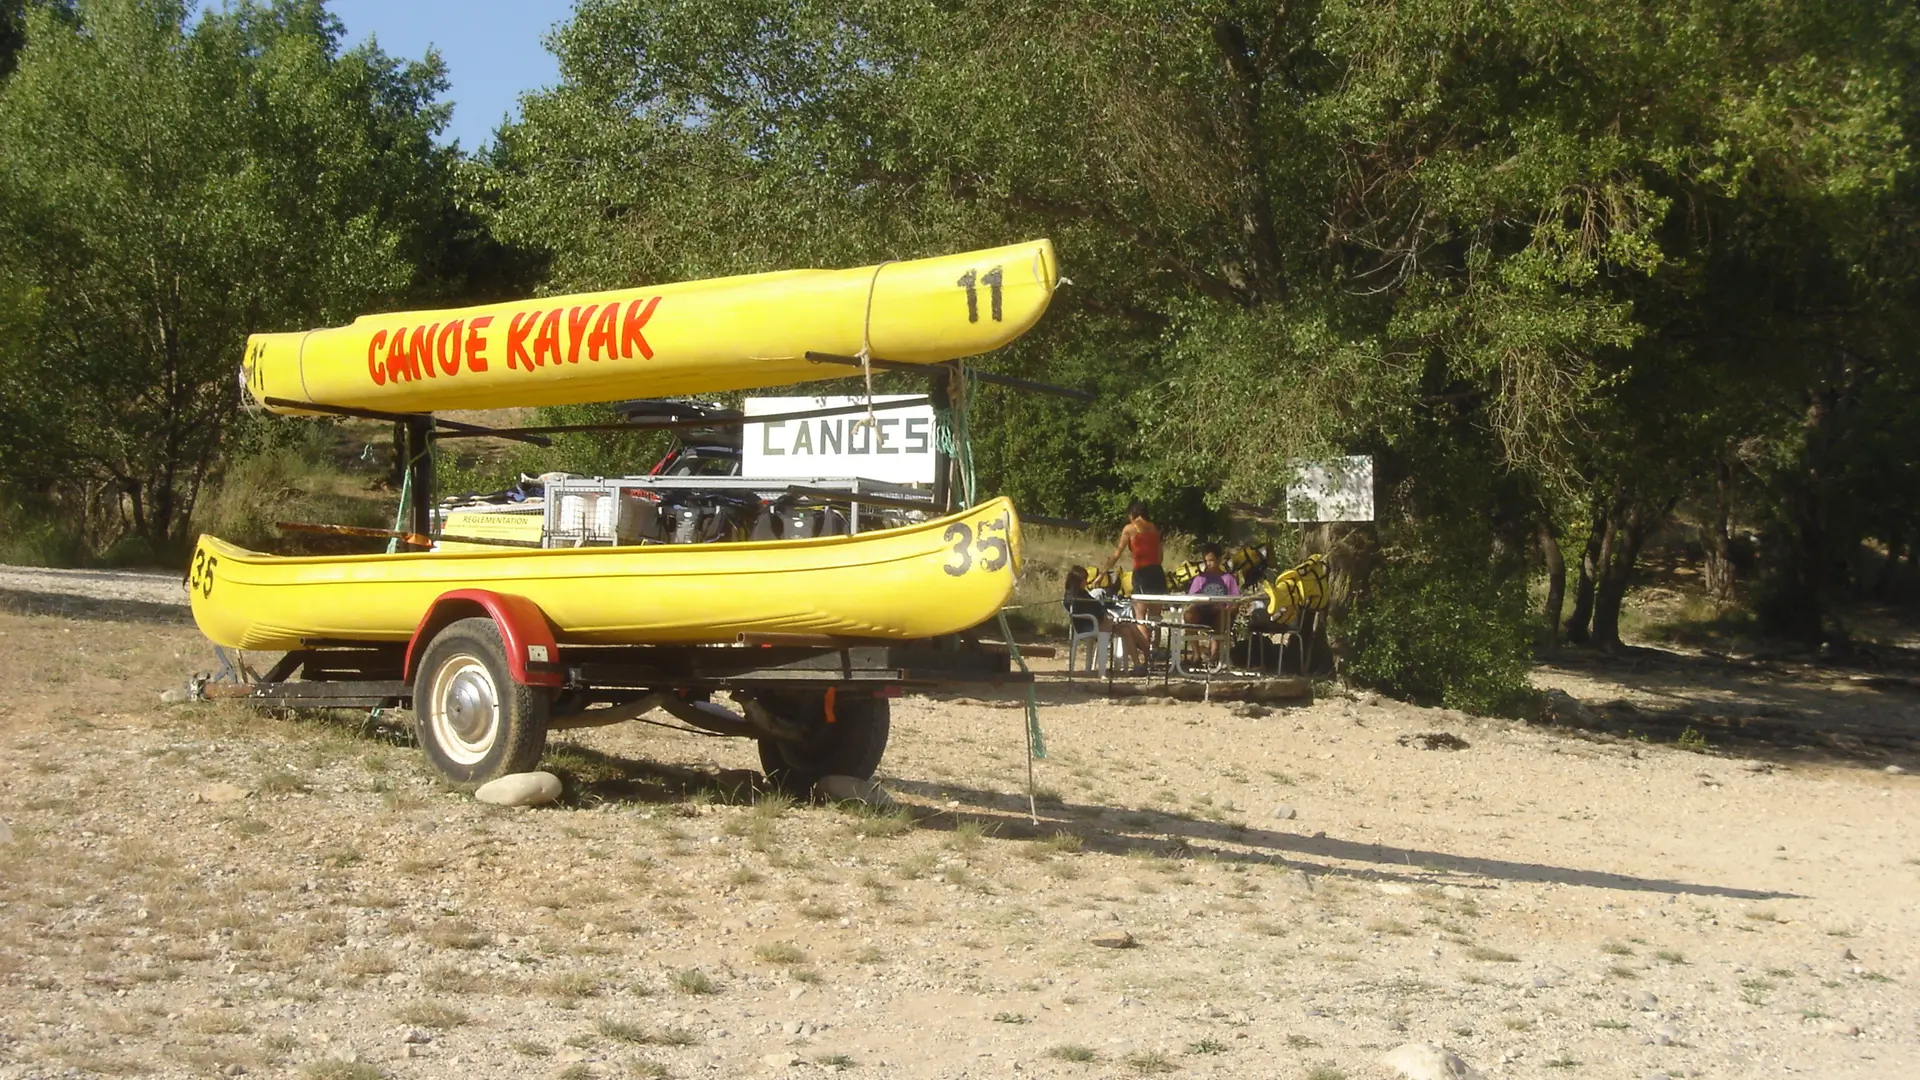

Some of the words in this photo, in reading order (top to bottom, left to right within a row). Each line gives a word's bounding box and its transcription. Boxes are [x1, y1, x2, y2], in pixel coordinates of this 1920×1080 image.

[957, 266, 1003, 323] 11
[368, 316, 495, 386] CANOE
[507, 296, 662, 373] KAYAK
[763, 417, 929, 456] CANOES
[192, 548, 218, 600] 35
[944, 520, 1008, 577] 35
